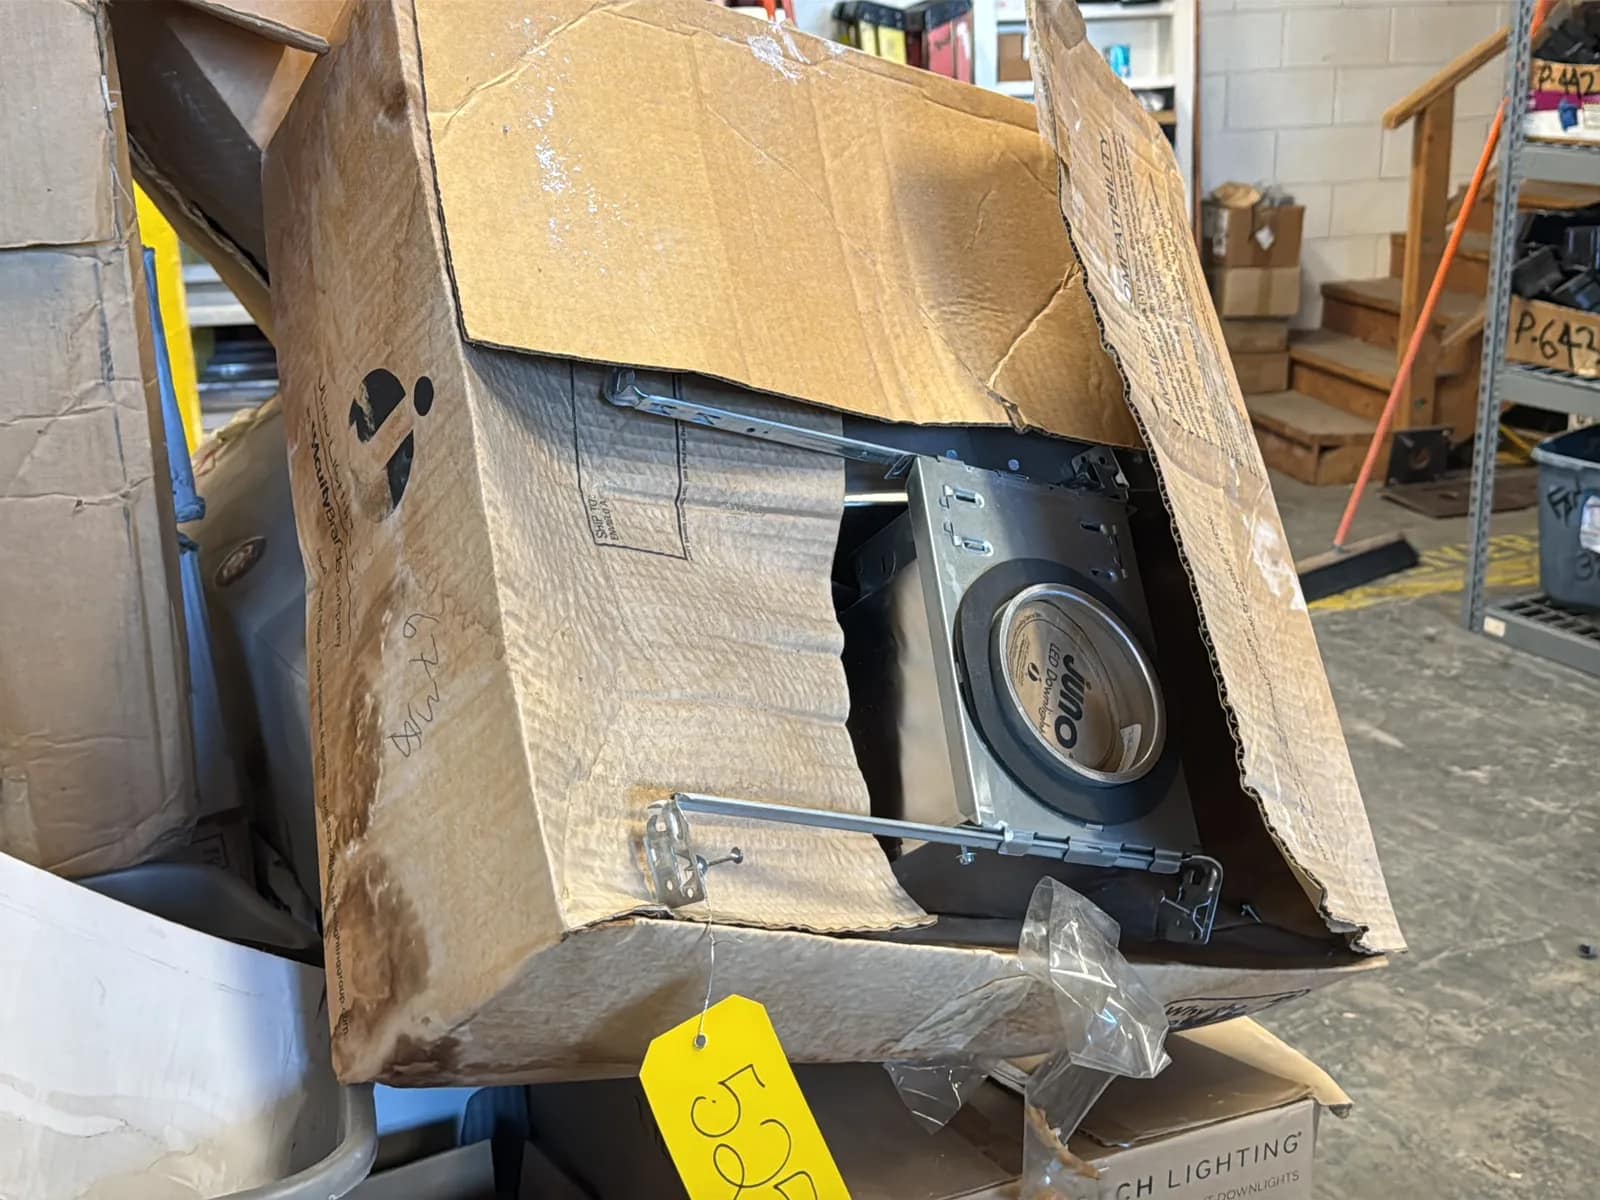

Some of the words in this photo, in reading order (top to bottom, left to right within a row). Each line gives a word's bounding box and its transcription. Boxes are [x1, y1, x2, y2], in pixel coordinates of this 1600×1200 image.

[1100, 132, 1134, 306] OMPATIBILITY
[592, 515, 608, 540] SHIP
[1048, 642, 1060, 669] LED
